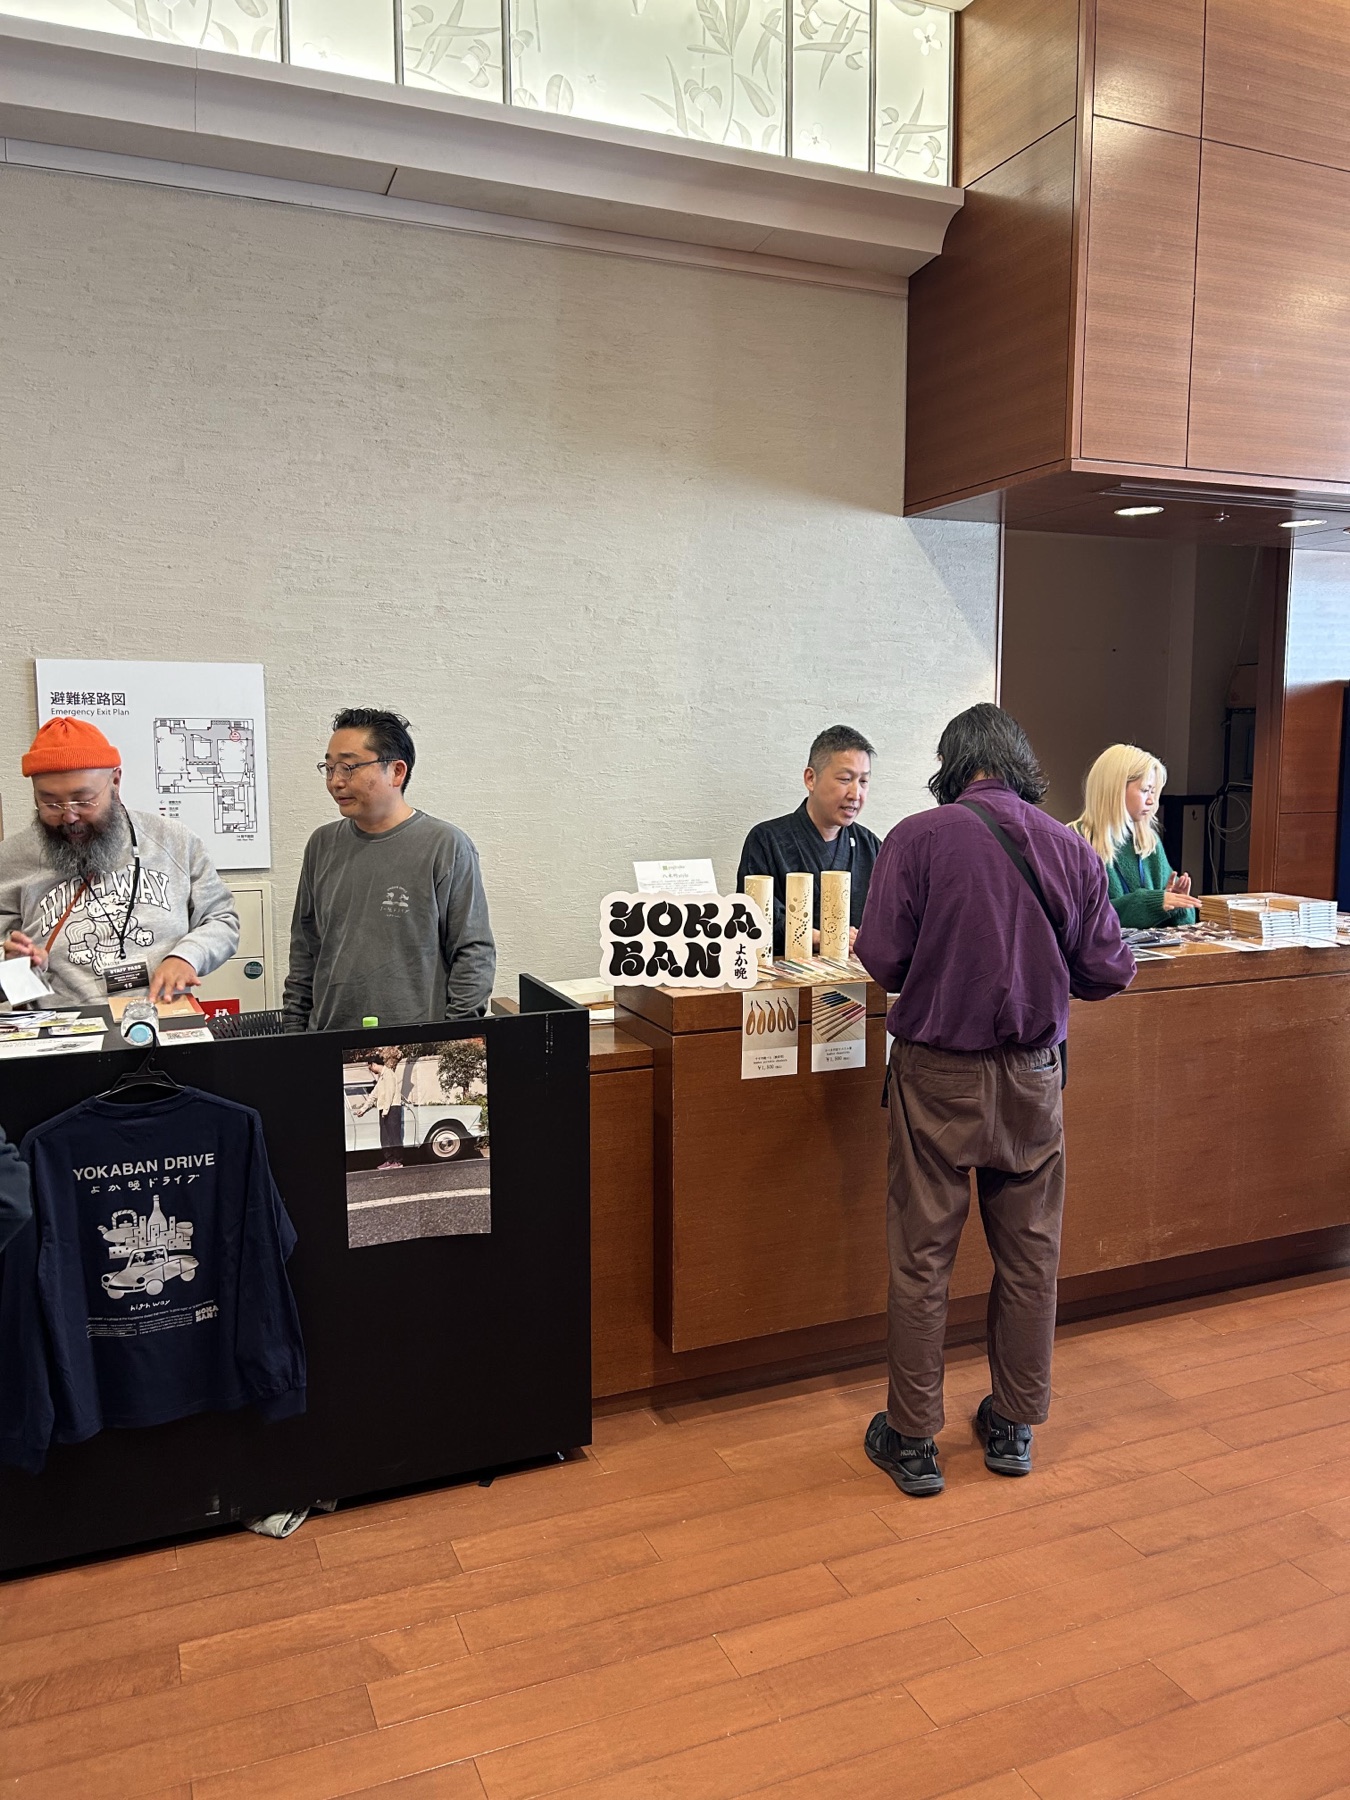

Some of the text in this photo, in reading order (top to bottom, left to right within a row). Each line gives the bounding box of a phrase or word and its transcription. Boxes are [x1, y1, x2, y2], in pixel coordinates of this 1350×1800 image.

[50, 691, 126, 706] 避難経路図
[51, 708, 130, 717] Emergency Exit Plan
[609, 900, 762, 940] YOKA
[127, 964, 142, 972] PASS
[609, 940, 722, 978] BAN
[734, 943, 748, 980] よか晩
[72, 1152, 216, 1181] YOKABAN DRIVE
